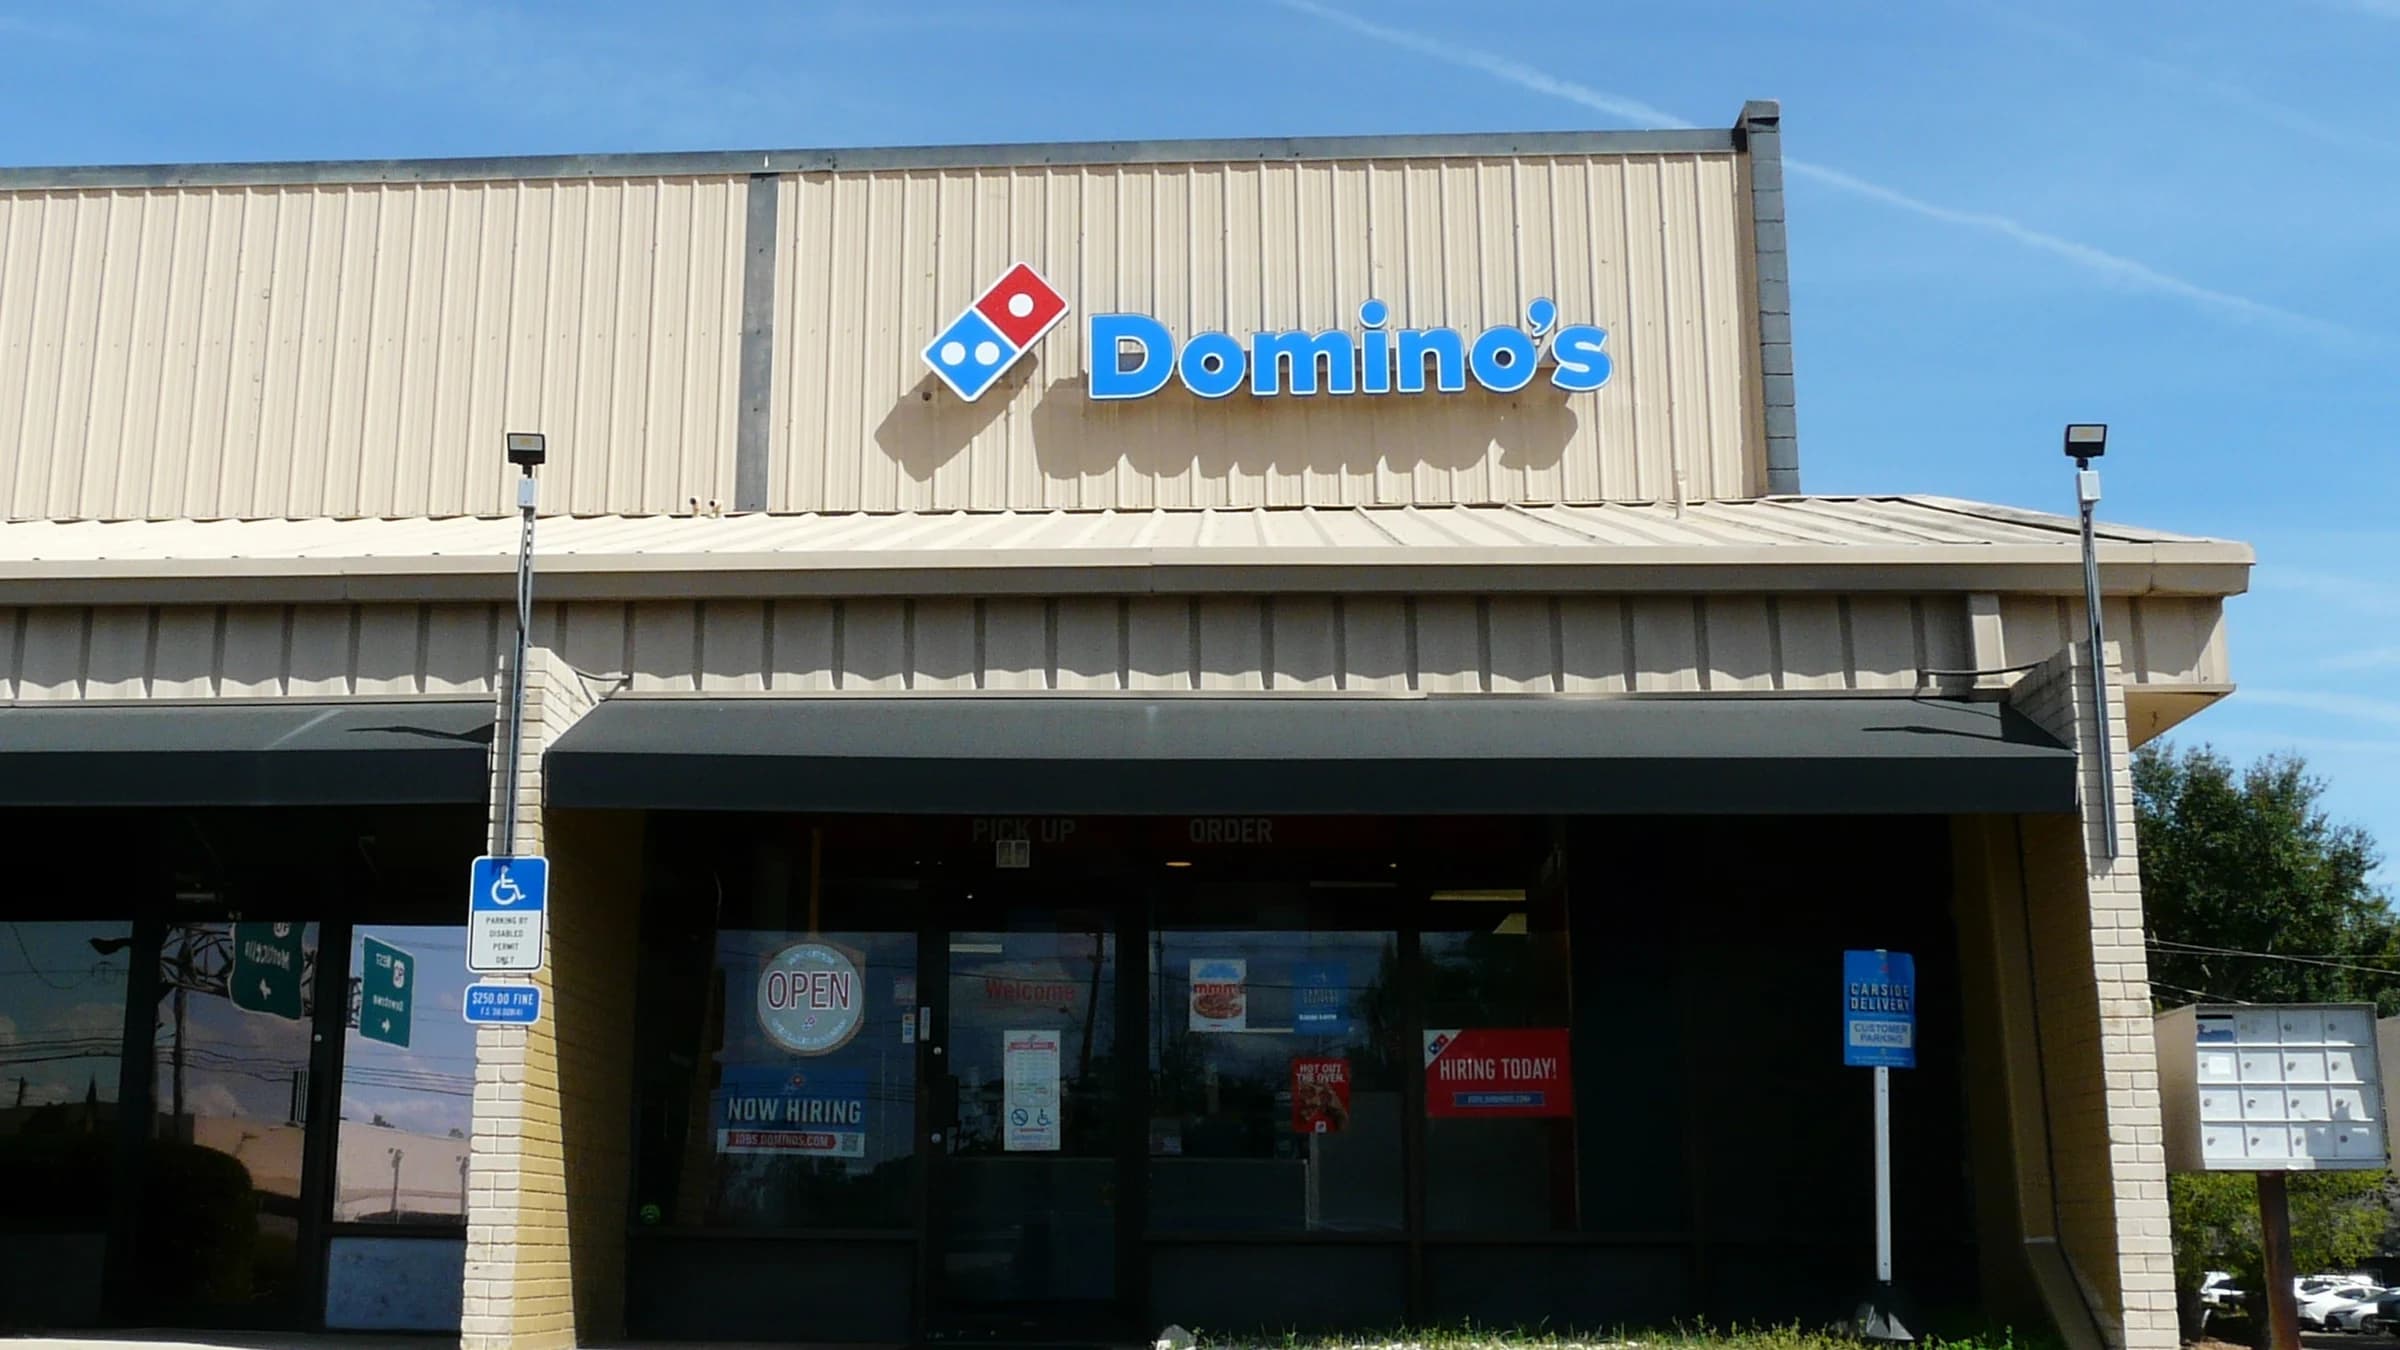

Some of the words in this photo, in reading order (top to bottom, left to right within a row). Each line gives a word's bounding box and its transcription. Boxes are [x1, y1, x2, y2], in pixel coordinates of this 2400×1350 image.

[1089, 297, 1614, 399] Domino's
[972, 817, 1031, 844] PICK
[1040, 817, 1078, 844] UP
[1188, 817, 1273, 844] ORDER
[486, 916, 517, 925] PARKING
[519, 916, 529, 925] BY
[489, 929, 524, 938] DISABLED
[493, 942, 520, 951] PERMIT
[766, 970, 851, 1010] OPEN
[986, 979, 1074, 1001] Welcome
[1850, 983, 1911, 997] CARSIDE
[472, 991, 510, 1005] $250.00
[513, 993, 534, 1006] FINE
[1850, 997, 1911, 1012] DELIVERY
[1854, 1022, 1909, 1035] CUSTOMER
[1860, 1033, 1905, 1044] PARKING
[1299, 1063, 1320, 1073] HOT
[1321, 1063, 1343, 1073] OUT
[1440, 1058, 1497, 1081] HIRING
[1501, 1057, 1558, 1081] TODAY!
[1296, 1073, 1315, 1083] THE
[728, 1096, 780, 1121] NOW
[786, 1098, 863, 1124] HIRING
